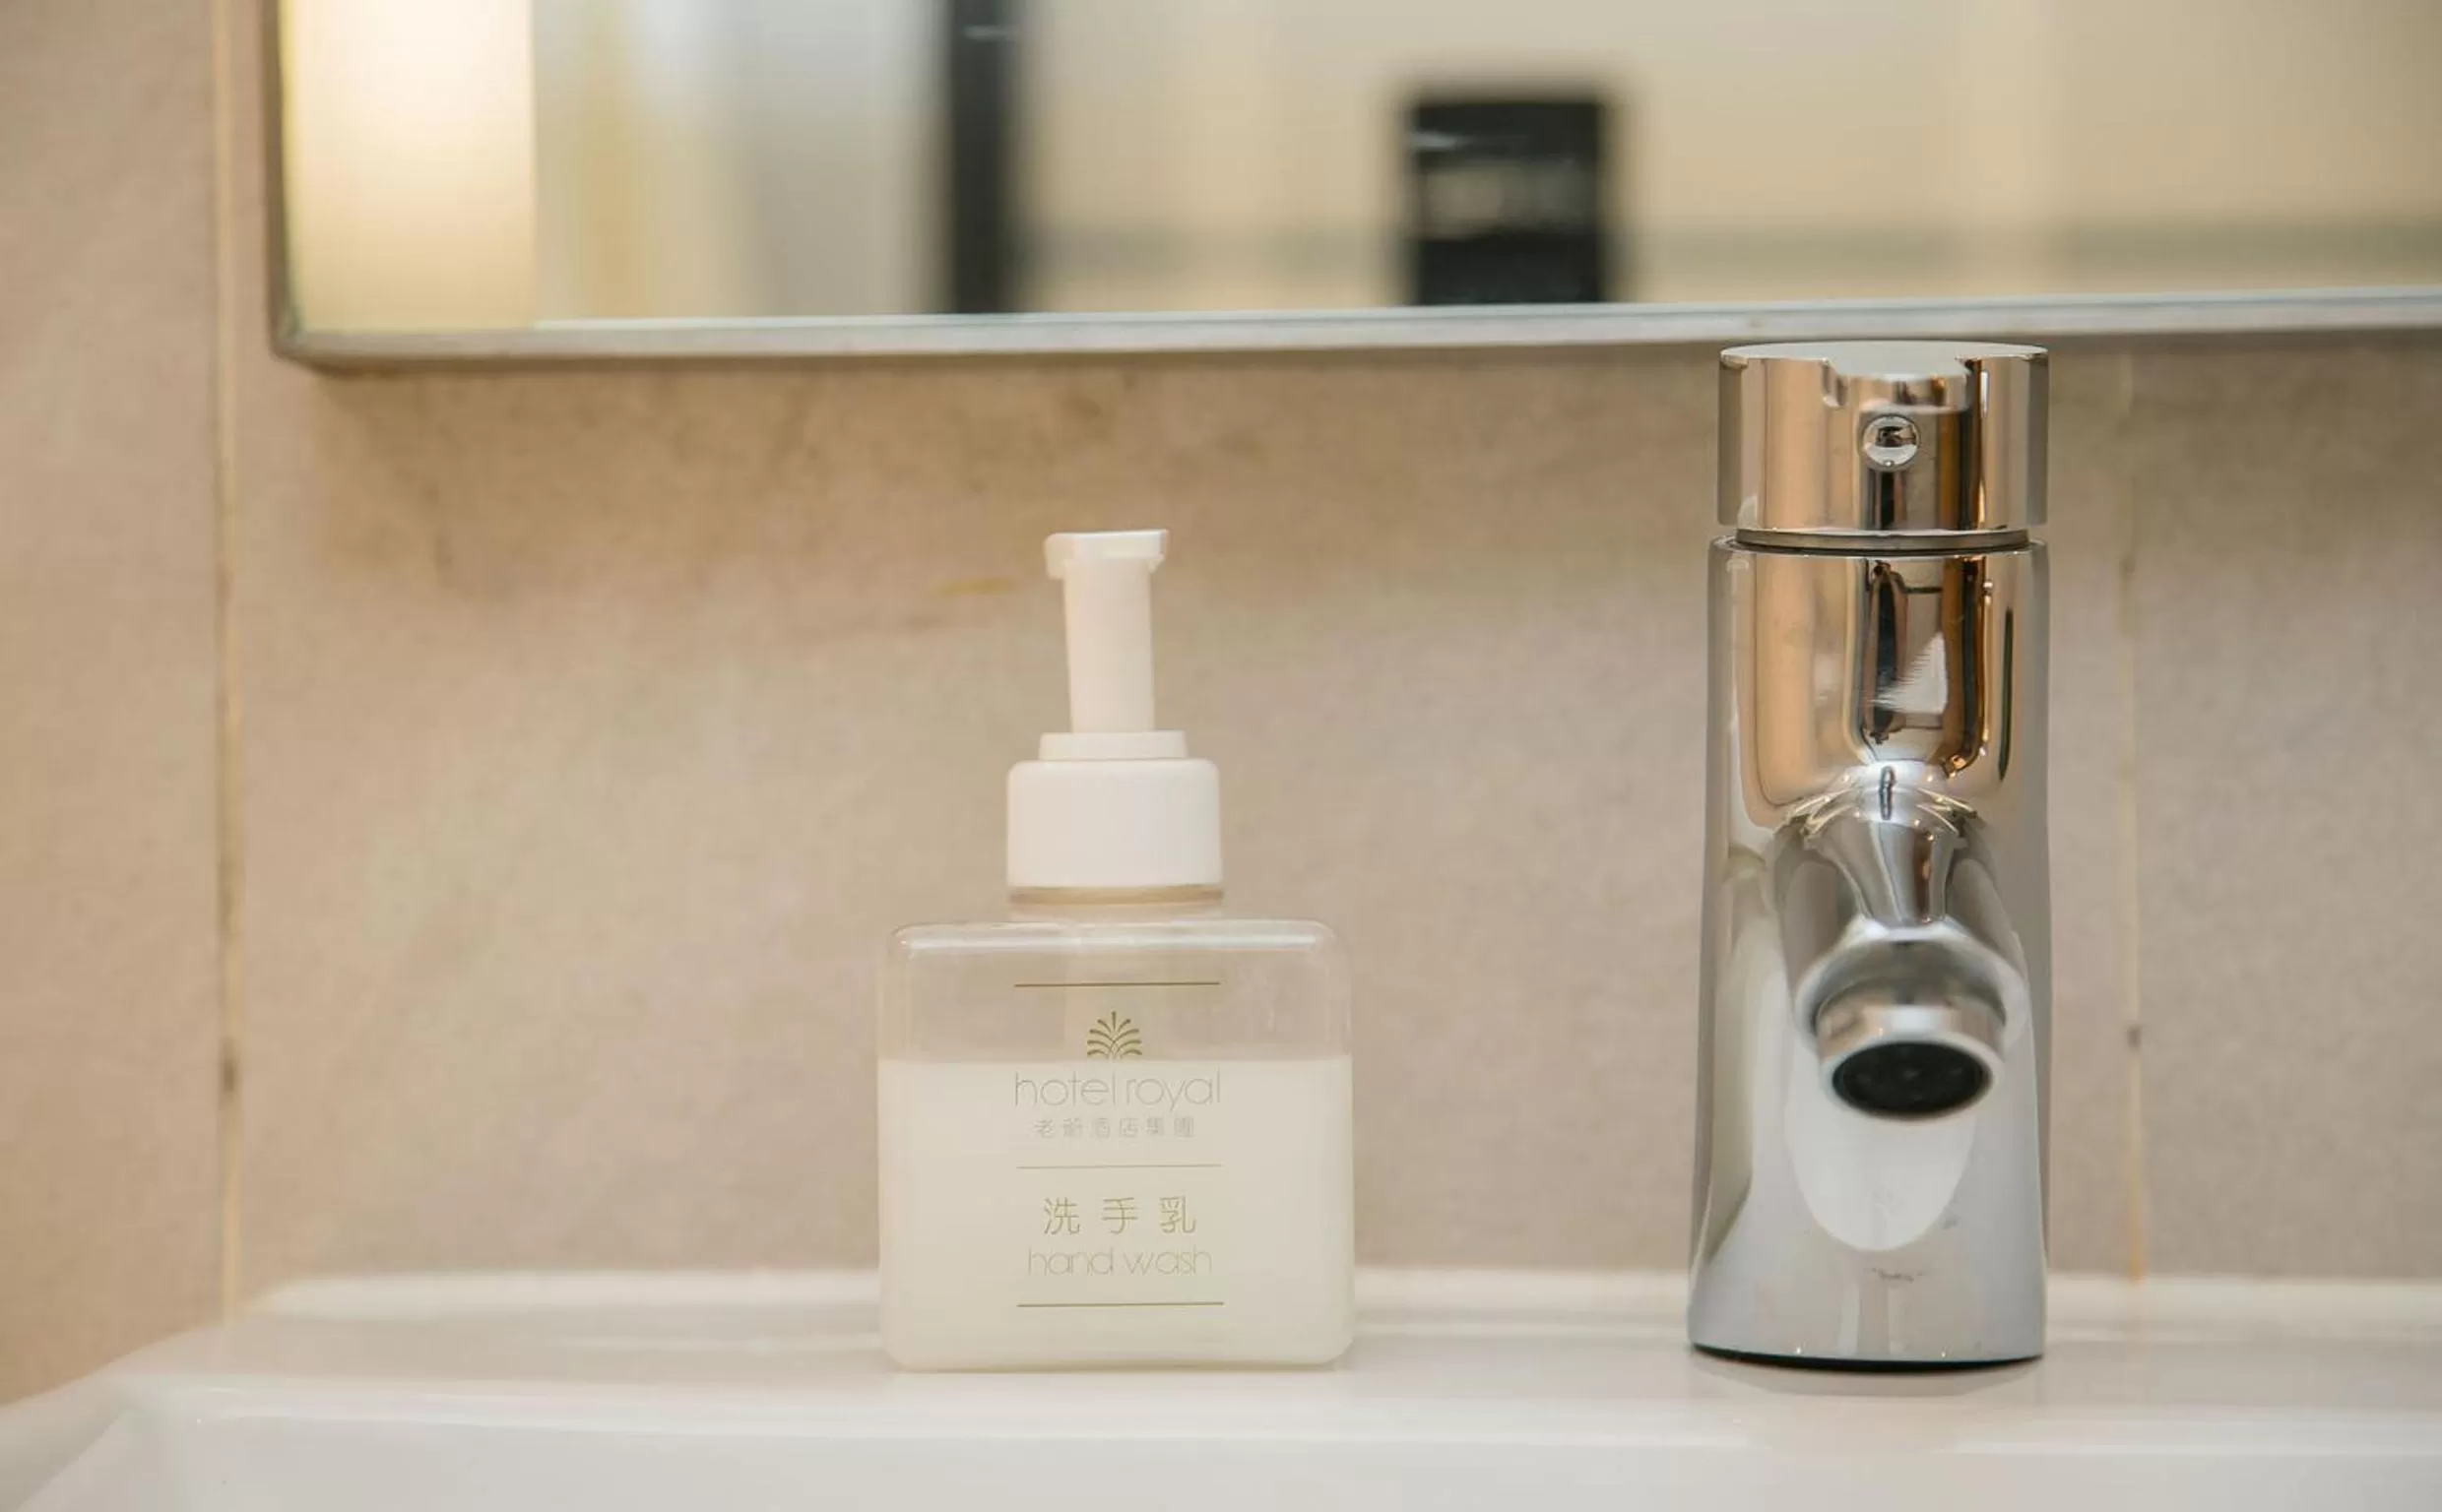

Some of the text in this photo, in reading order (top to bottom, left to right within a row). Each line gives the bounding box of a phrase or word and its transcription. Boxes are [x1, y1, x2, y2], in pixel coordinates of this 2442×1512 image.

[1014, 1068, 1222, 1113] hotel royal
[1043, 1194, 1197, 1235] 洗手乳
[1027, 1244, 1213, 1277] hand wash
